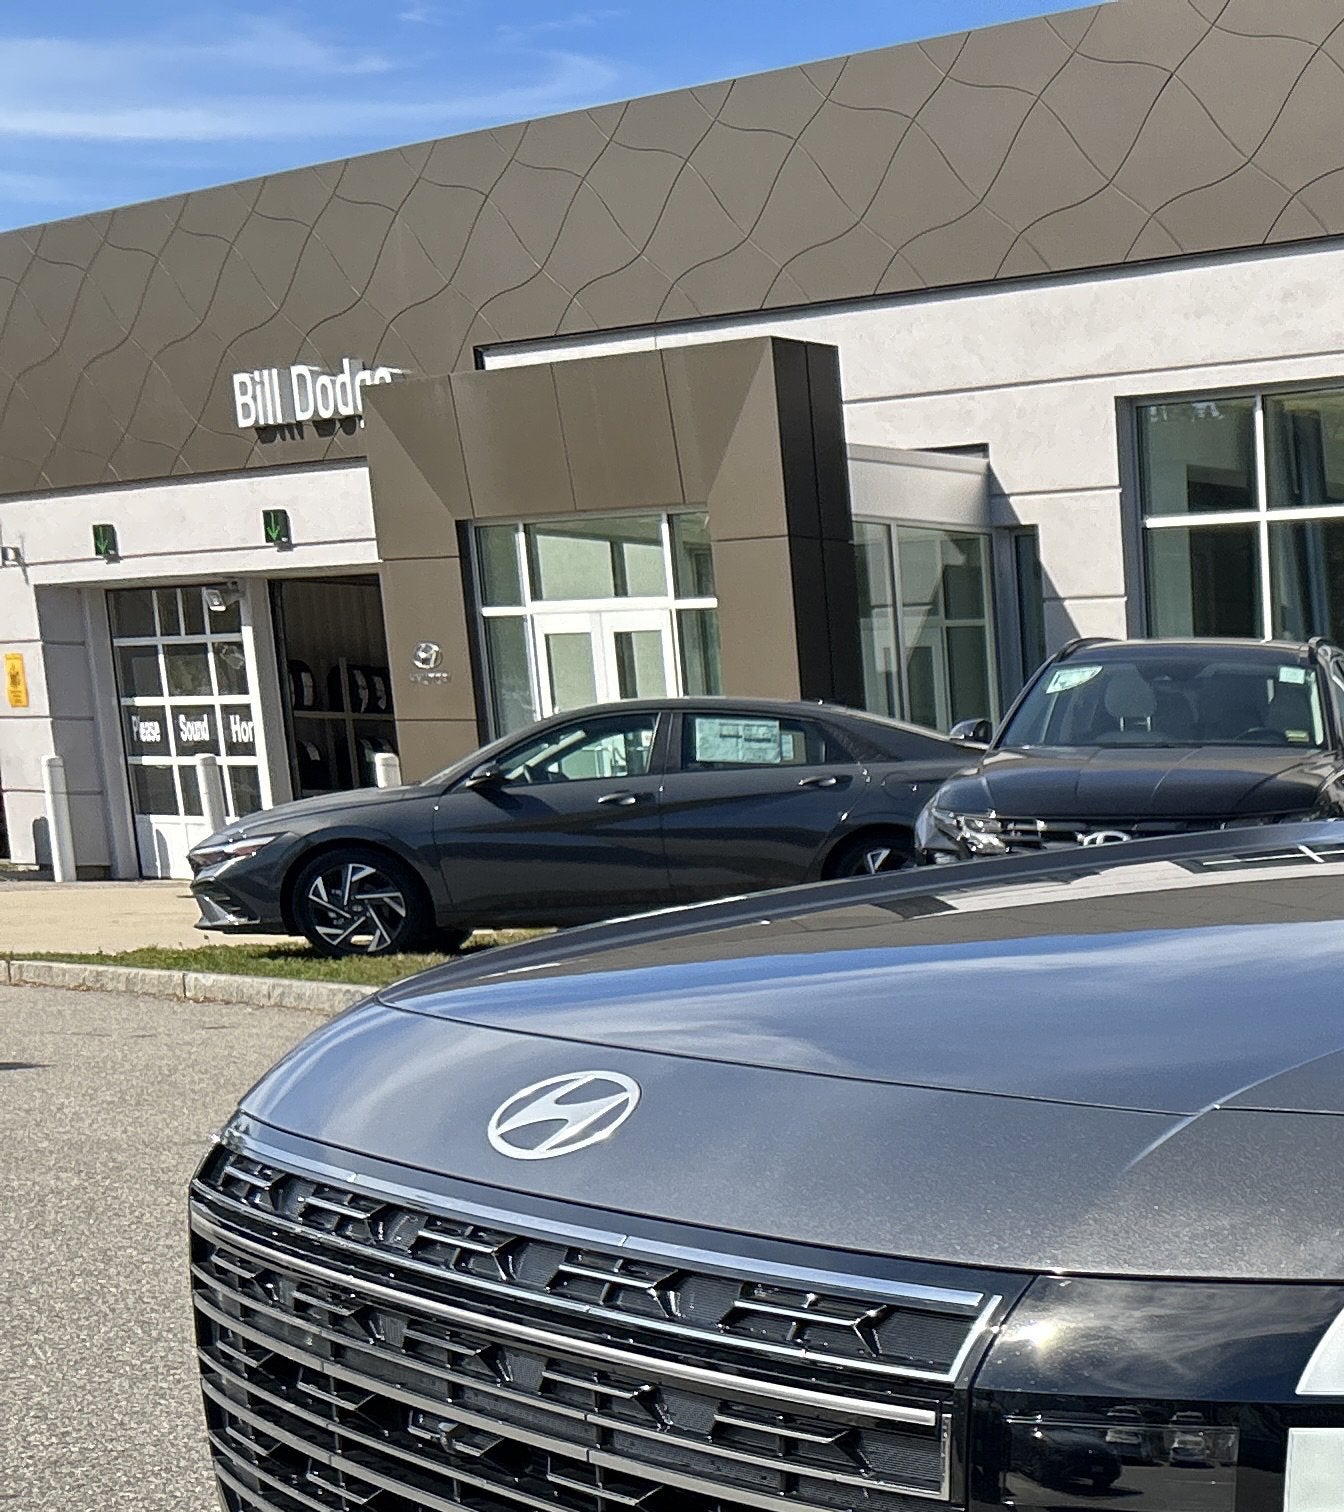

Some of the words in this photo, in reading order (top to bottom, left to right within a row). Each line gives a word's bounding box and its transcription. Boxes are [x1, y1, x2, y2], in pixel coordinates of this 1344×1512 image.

[232, 367, 284, 429] Bill
[289, 357, 393, 430] Dod
[178, 713, 210, 742] Sound
[229, 714, 255, 743] Hor
